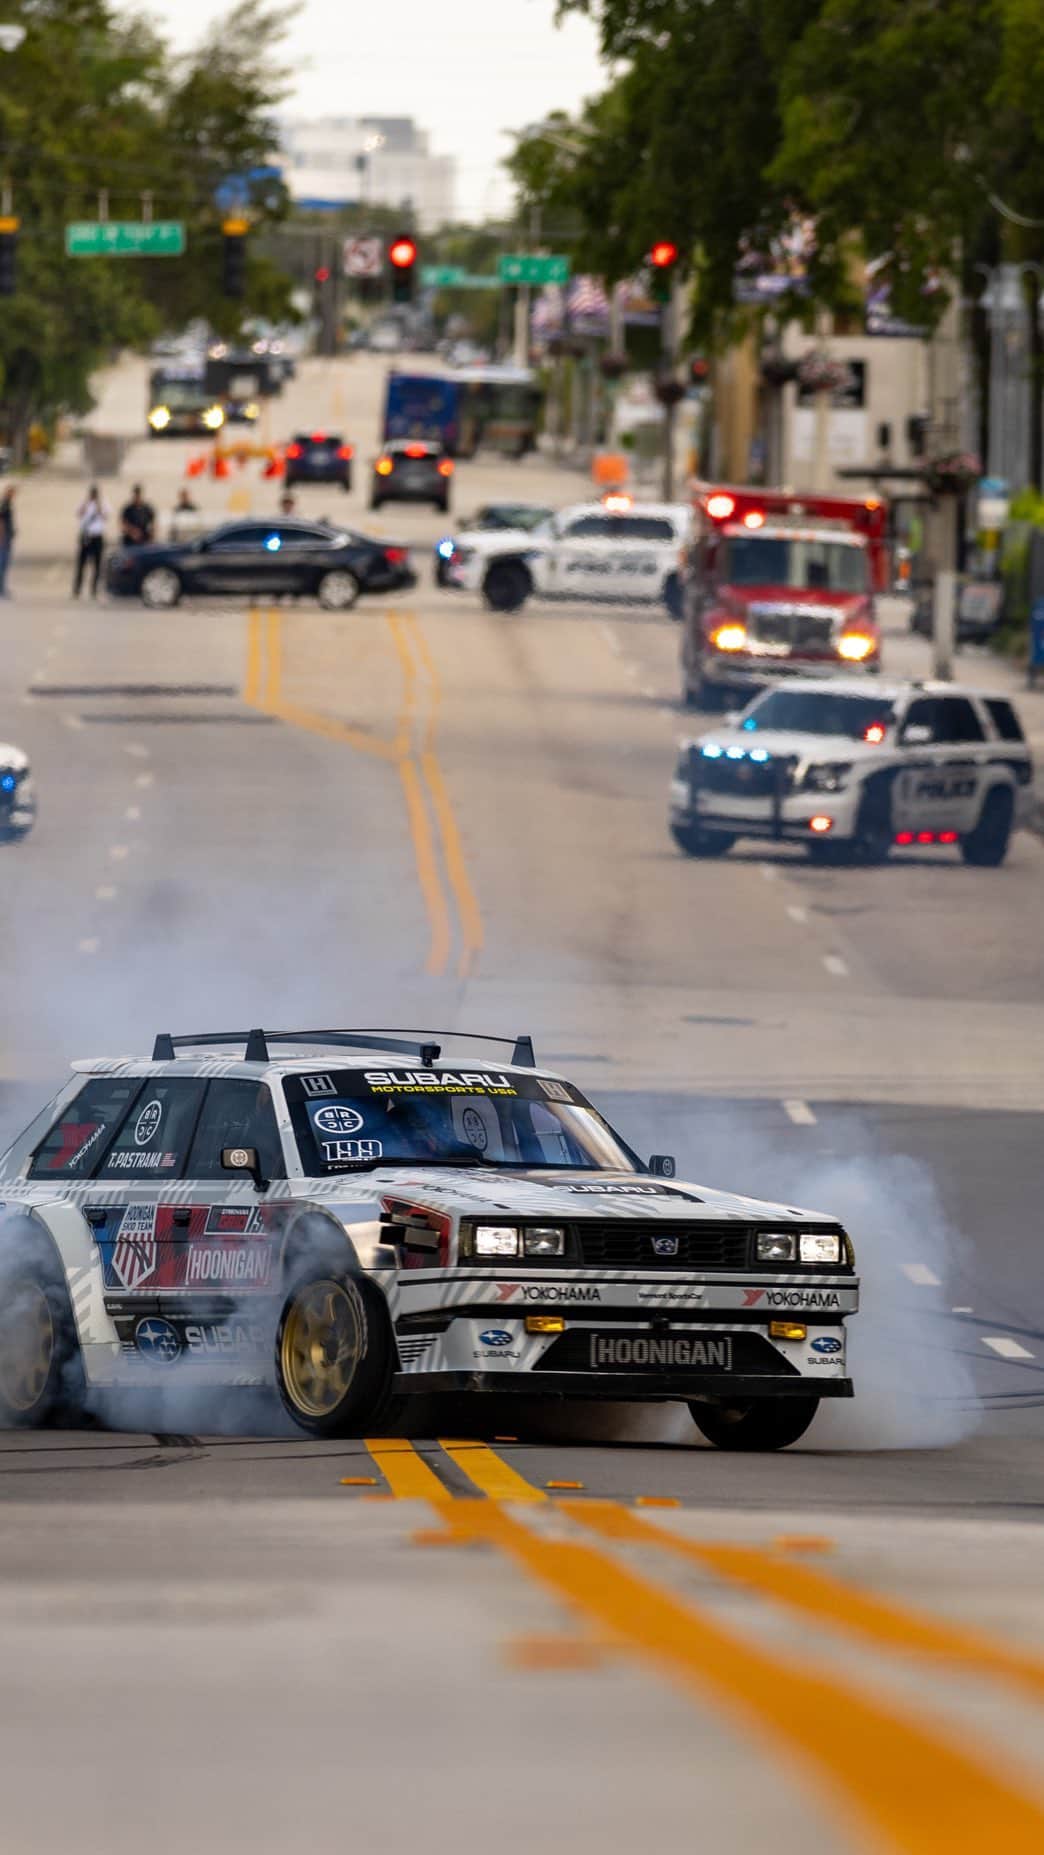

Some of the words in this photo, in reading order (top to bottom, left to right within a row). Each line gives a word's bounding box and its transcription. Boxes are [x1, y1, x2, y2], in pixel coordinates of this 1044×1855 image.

[364, 1072, 510, 1088] SUBARU
[371, 1086, 484, 1095] MOTORSPORTS
[487, 1088, 517, 1096] USA
[68, 1123, 107, 1168] YOKOHAMA
[321, 1139, 383, 1161] 199
[108, 1152, 162, 1168] T.PASTRANA
[556, 1184, 657, 1194] SUBARU
[126, 1204, 155, 1221] HOONIGAN
[121, 1221, 136, 1232] SKID
[138, 1221, 154, 1232] TEAM
[521, 1286, 601, 1301] YOKOHAMA
[765, 1291, 840, 1307] YOKOHAMA
[185, 1326, 274, 1353] SUBAR
[472, 1350, 521, 1359] SUBARU
